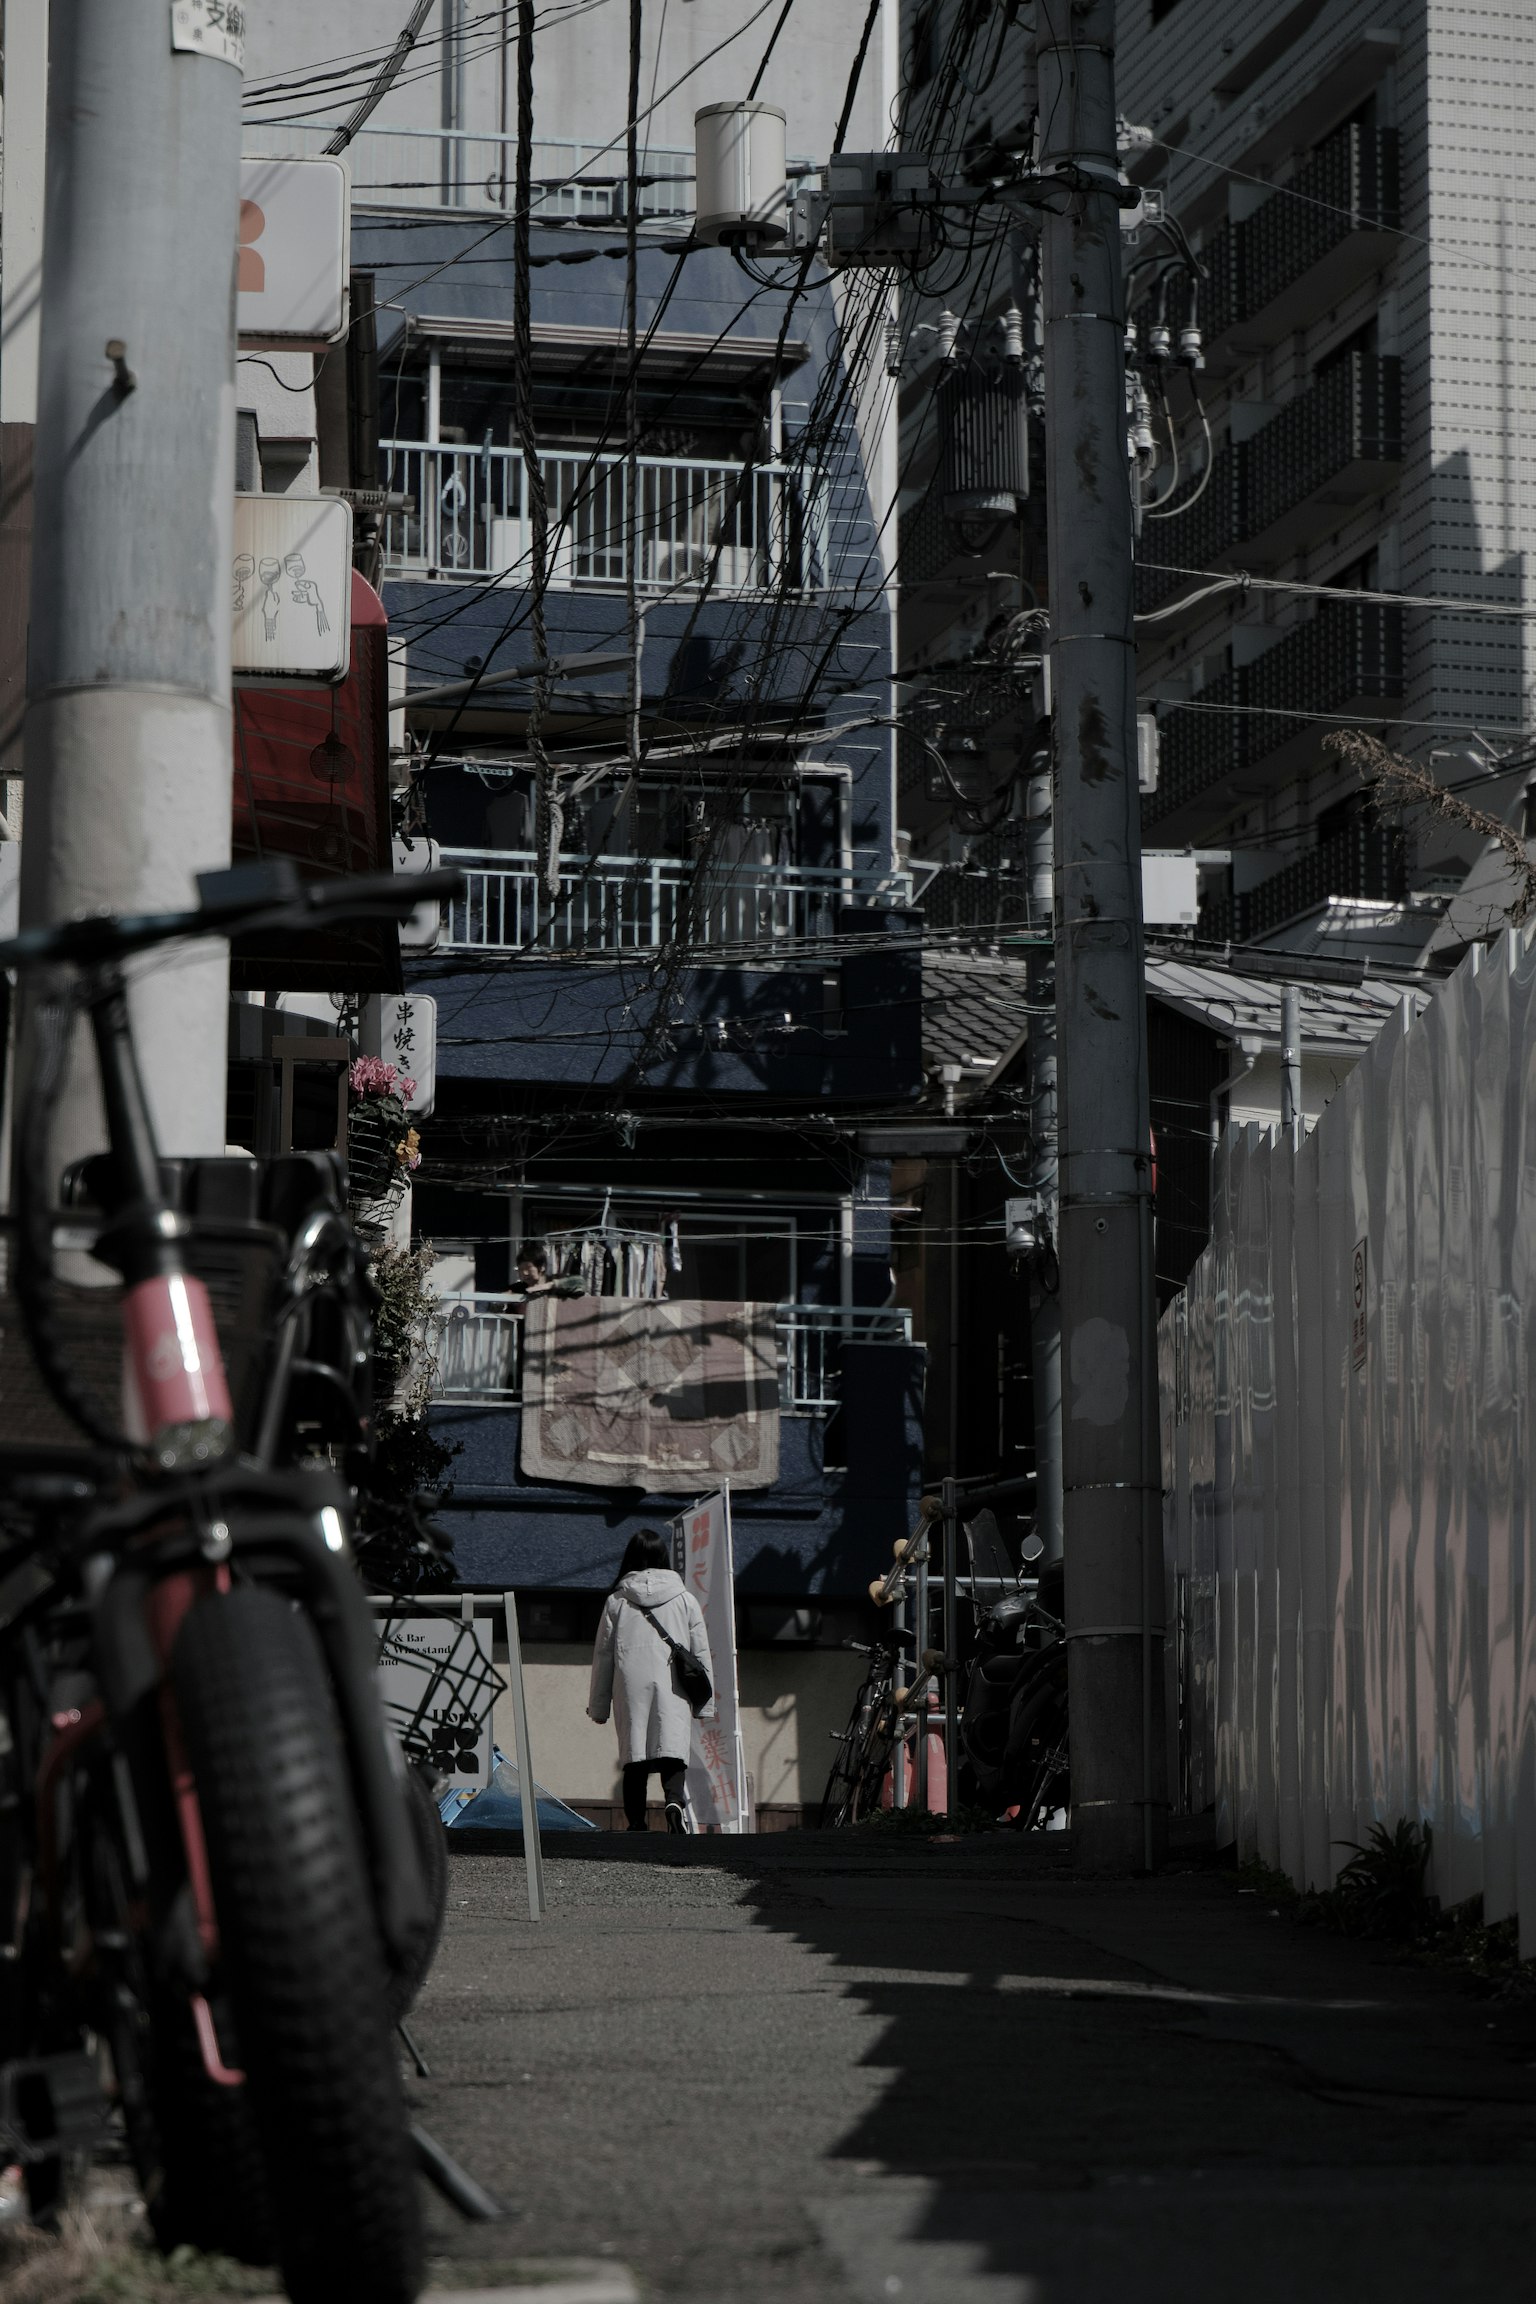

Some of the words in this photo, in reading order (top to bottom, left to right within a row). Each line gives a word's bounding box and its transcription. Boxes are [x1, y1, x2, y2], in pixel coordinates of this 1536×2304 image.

[393, 1001, 416, 1075] 串焼き
[394, 1633, 404, 1642] &
[407, 1633, 426, 1643] Bar
[422, 1645, 451, 1654] stand
[377, 1657, 399, 1667] and
